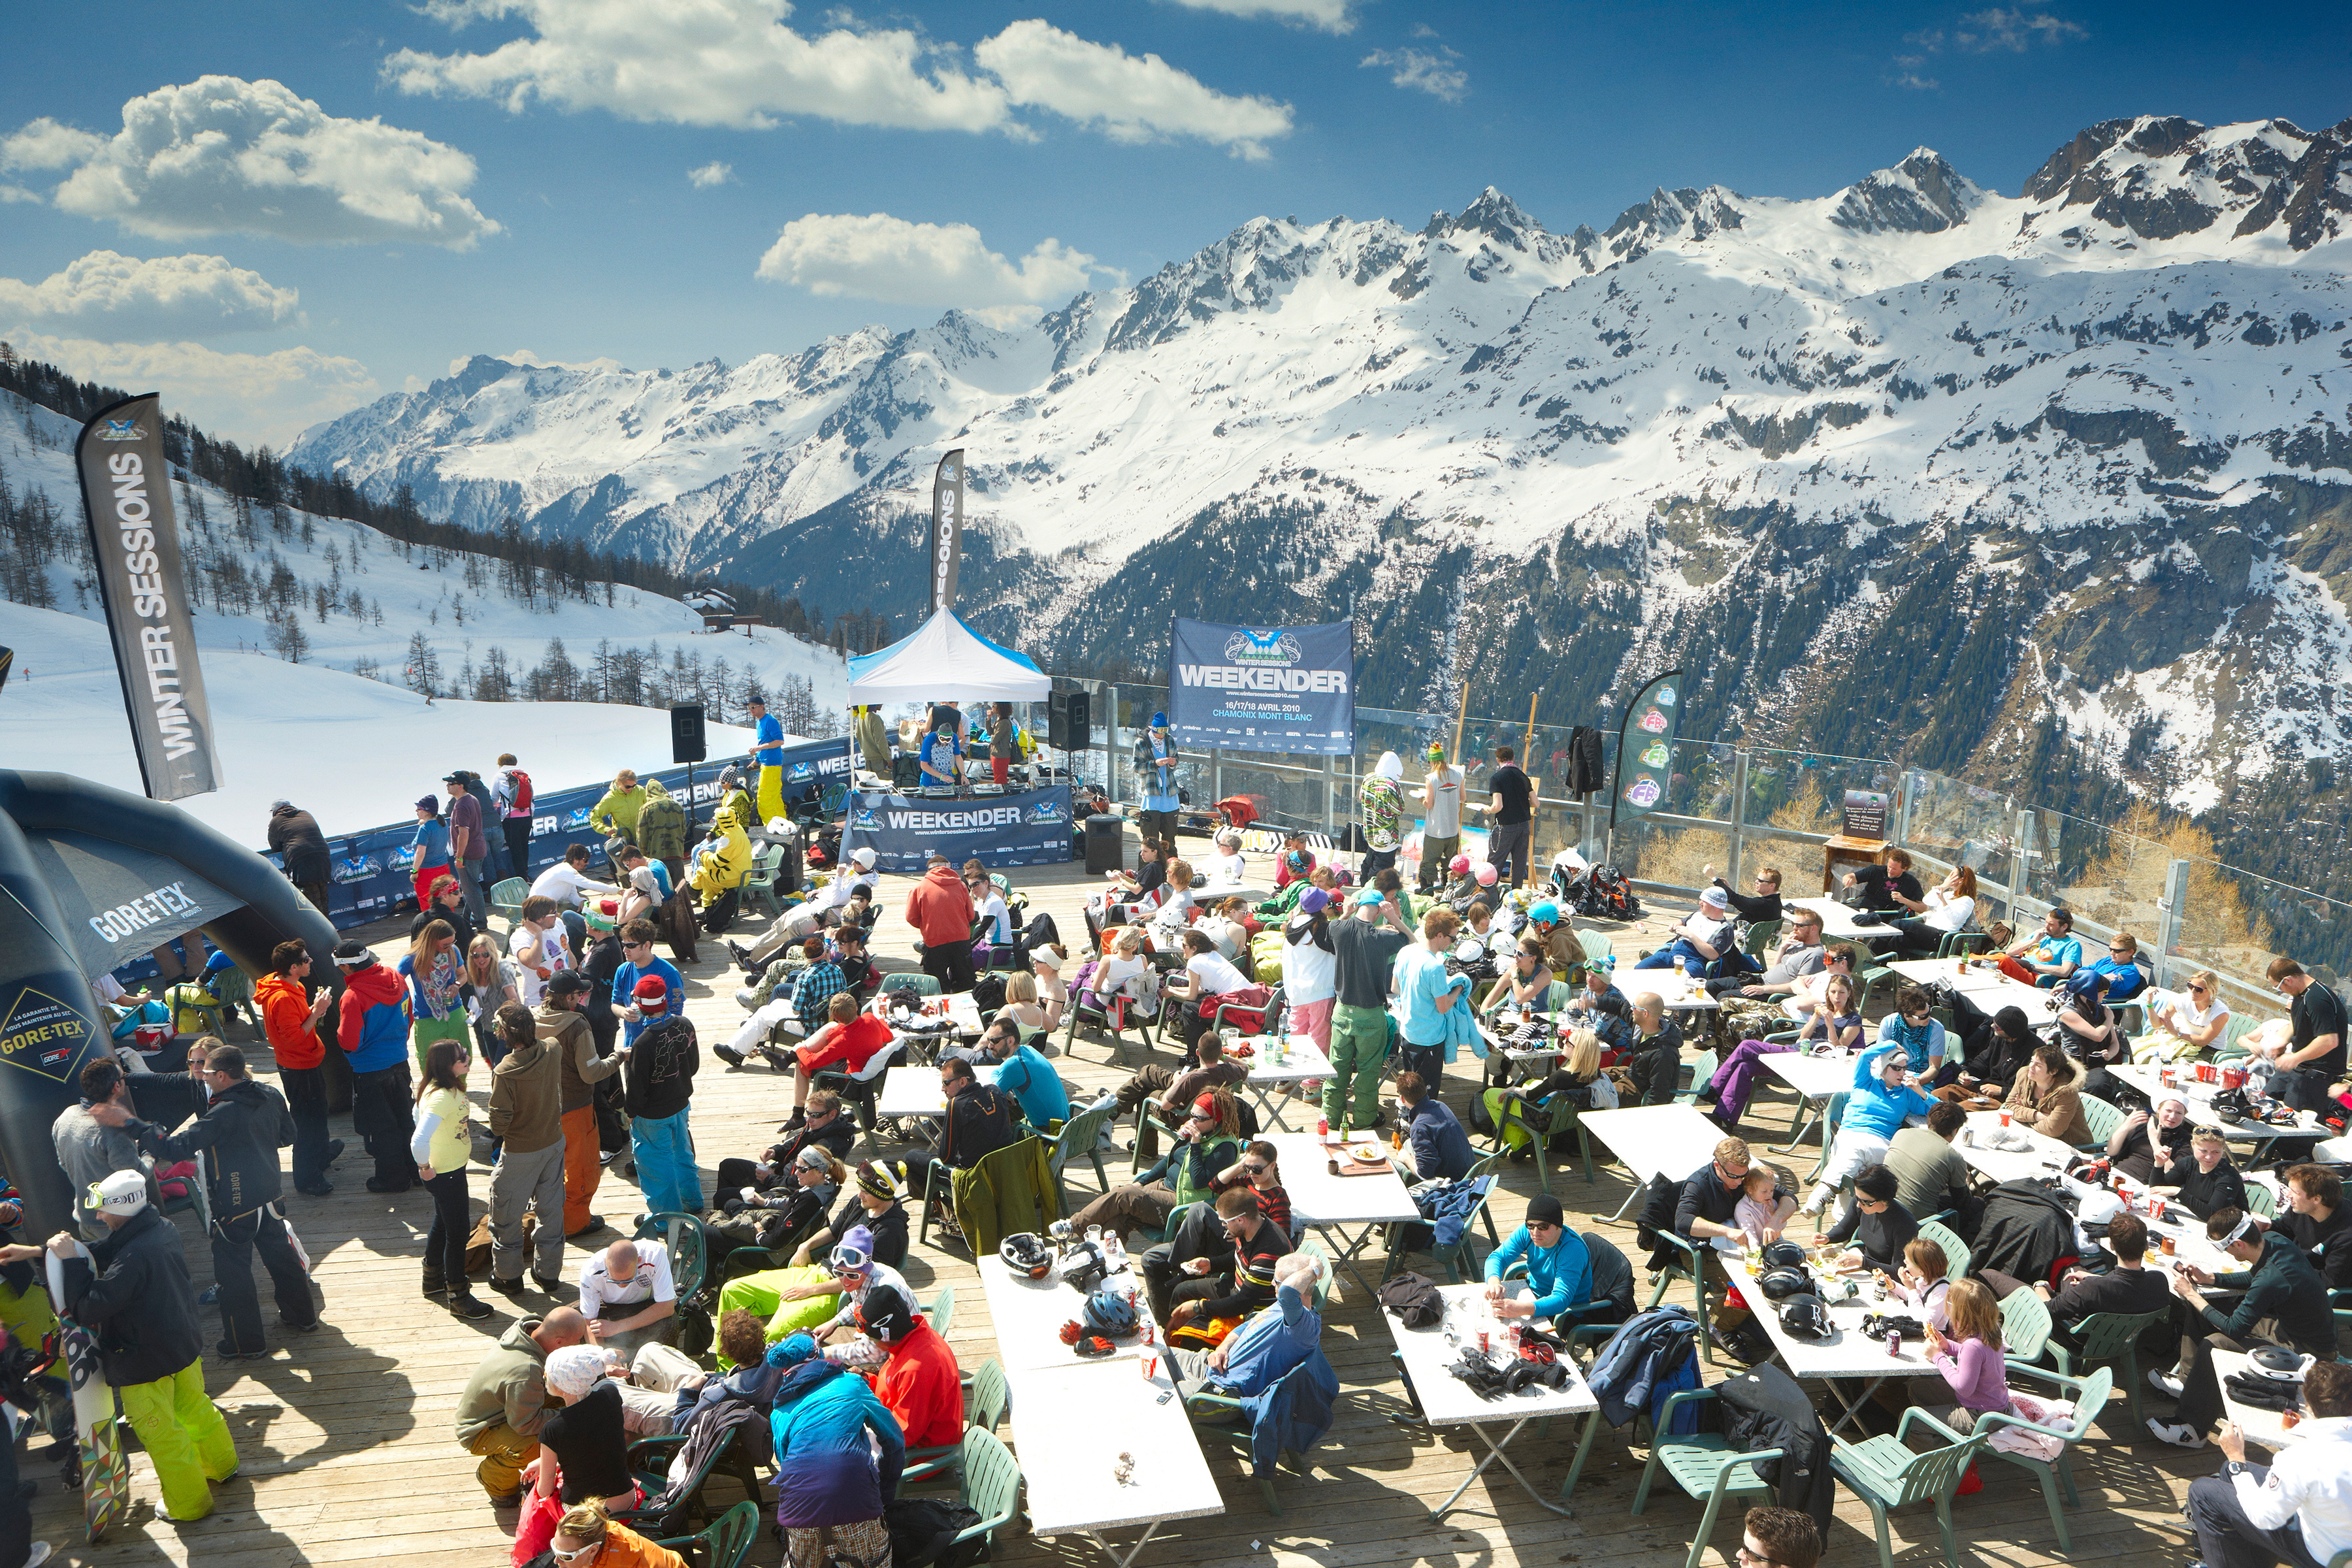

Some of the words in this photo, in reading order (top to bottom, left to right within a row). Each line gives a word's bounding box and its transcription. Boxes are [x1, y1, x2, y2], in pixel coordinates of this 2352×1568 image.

[108, 452, 167, 618] SESSIONS
[1179, 664, 1347, 693] WEEKENDER
[140, 625, 196, 762] WINTER
[1226, 691, 1299, 699] www.wintersessions2010.com
[1225, 700, 1256, 711] 16/17/18
[1257, 703, 1281, 711] AVRIL
[1213, 709, 1256, 719] CHAMONIX
[1258, 711, 1282, 720] MONT
[1284, 713, 1313, 722] BLANC
[1633, 785, 1655, 802] FB
[888, 806, 1021, 829] WEEKENDER
[915, 827, 996, 836] www.wintersessions2010.com
[180, 906, 203, 919] PRODUITS
[22, 1007, 50, 1019] GARANTIE
[6, 1022, 22, 1032] VOUS
[22, 1013, 52, 1026] MAINTENIR
[1, 1020, 85, 1054] GORE-TEX
[44, 1053, 59, 1063] GORE
[231, 1171, 242, 1206] GORE-TEX
